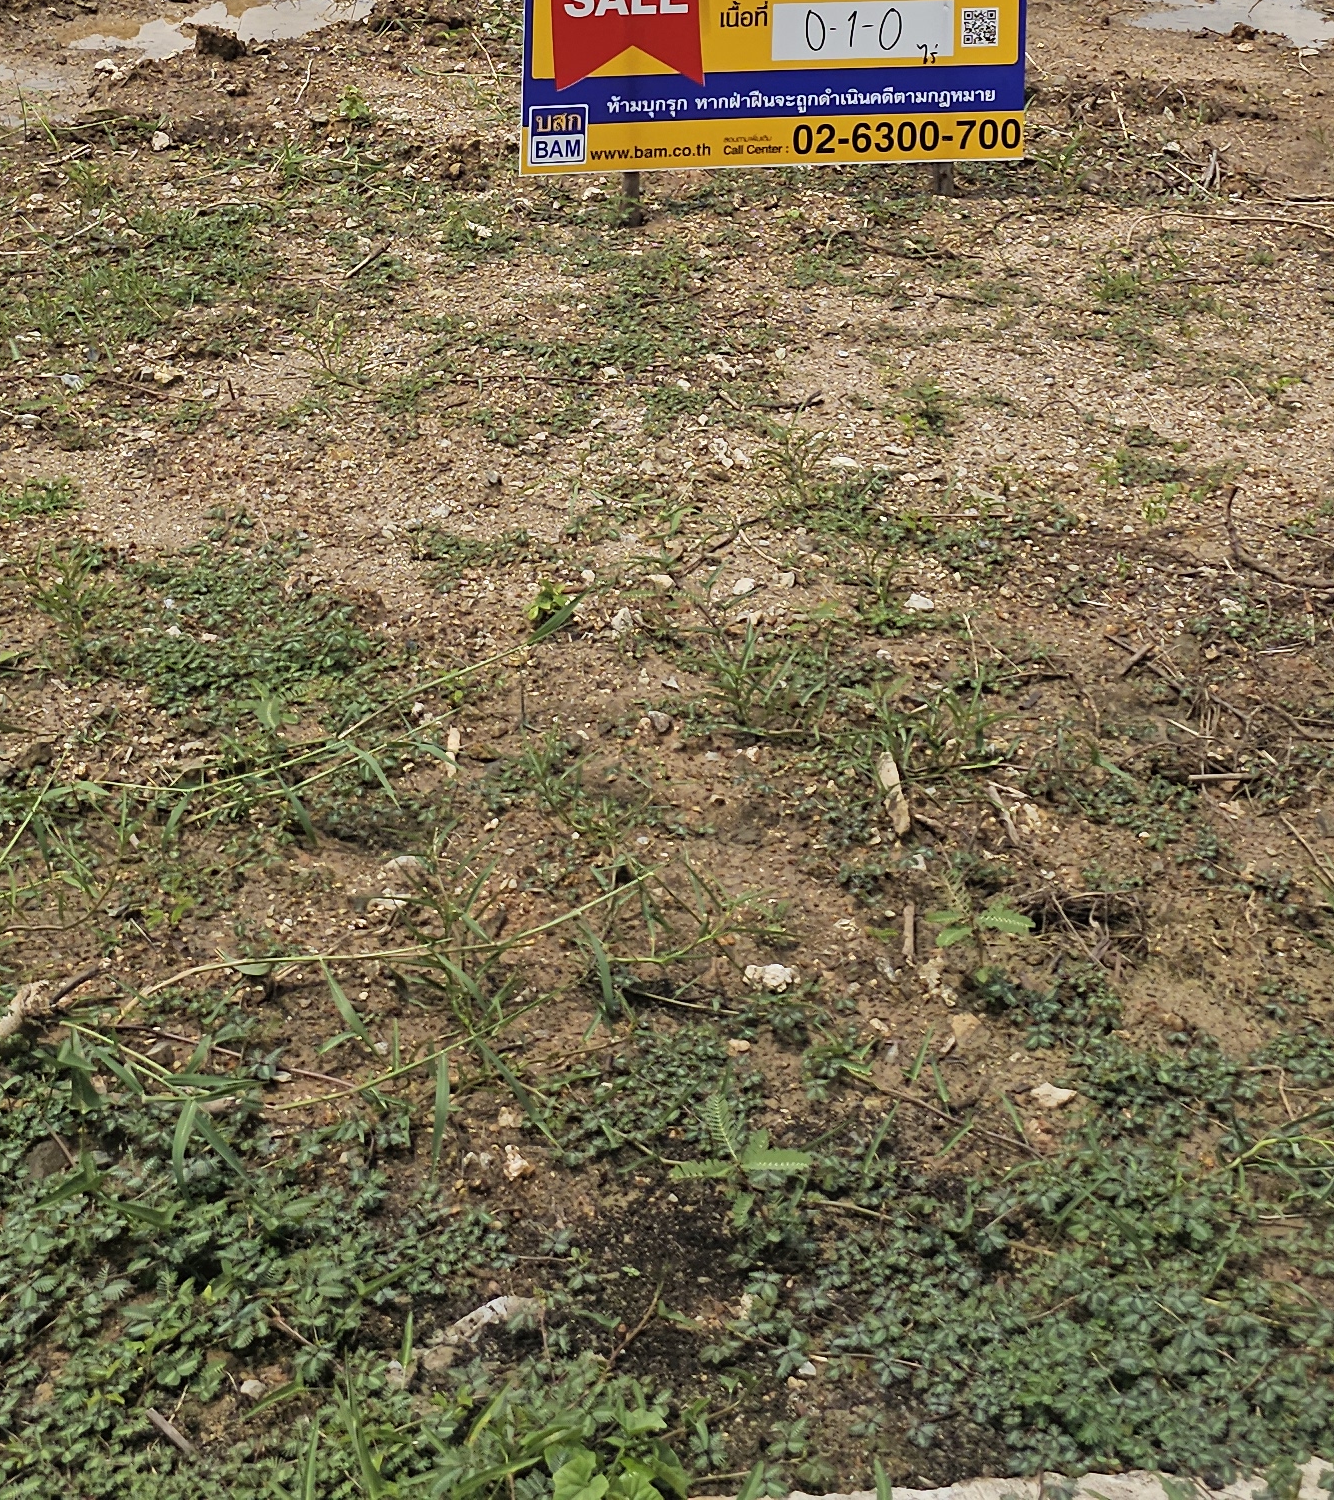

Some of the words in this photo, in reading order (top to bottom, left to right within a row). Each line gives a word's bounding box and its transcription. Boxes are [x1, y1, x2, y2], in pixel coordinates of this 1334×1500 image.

[720, 1, 769, 28] เนื้อที่
[805, 8, 902, 51] 0-1-0
[606, 95, 688, 118] ห้ามบุกรุก
[535, 112, 582, 133] บสก
[793, 118, 1021, 155] 02-6300-700
[535, 139, 581, 159] BAM
[590, 143, 711, 160] www.bam.co.th
[723, 145, 744, 155] Call
[747, 144, 783, 154] Center
